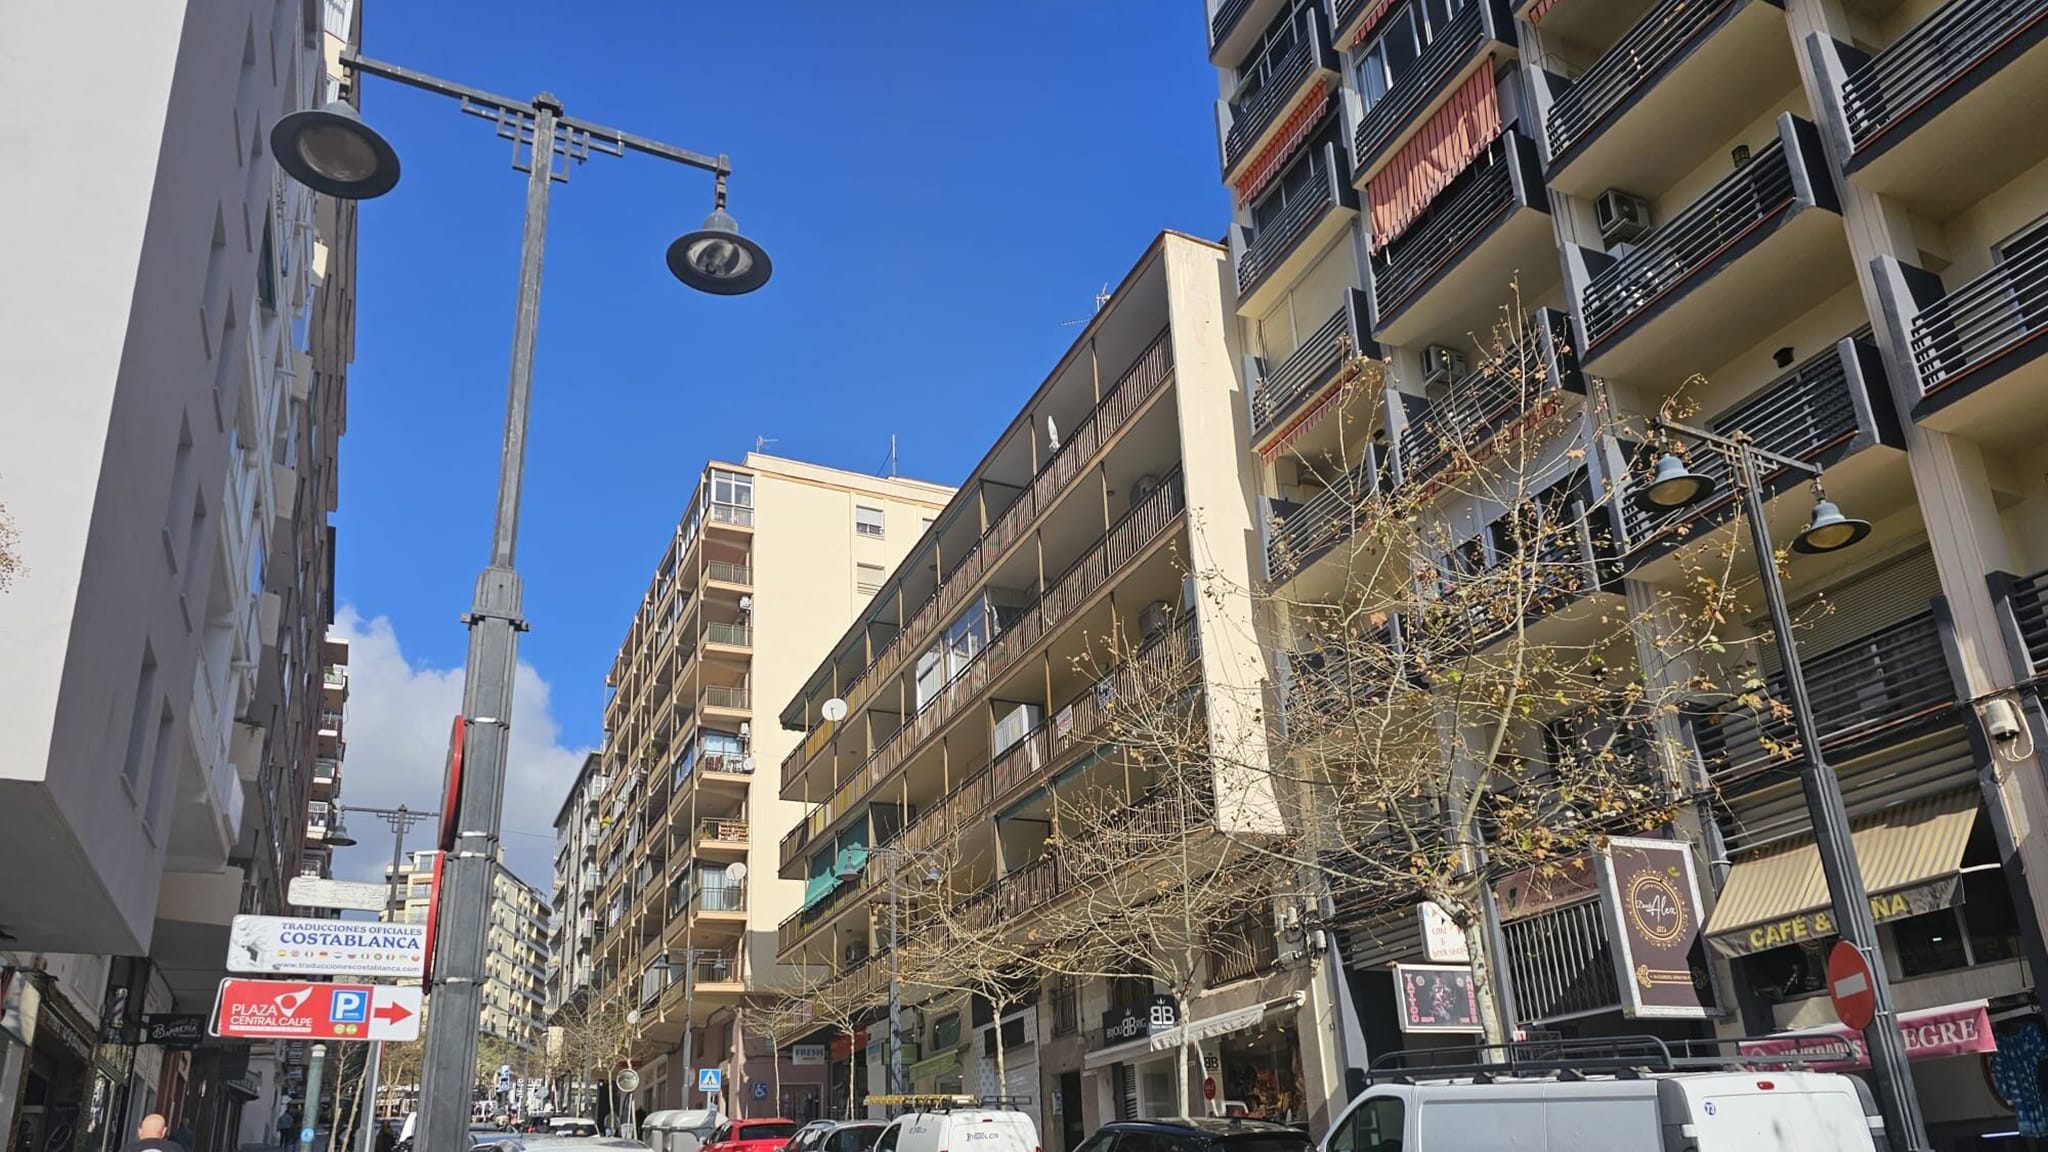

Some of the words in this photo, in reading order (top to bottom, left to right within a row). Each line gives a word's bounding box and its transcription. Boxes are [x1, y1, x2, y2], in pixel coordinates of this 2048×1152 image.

[1646, 895, 1677, 924] Alex
[279, 931, 420, 950] COSTABLANCA
[281, 922, 367, 934] TRADUCCIONES
[368, 926, 423, 936] OFICIALES
[1750, 914, 1807, 948] CAFÉ
[1814, 912, 1832, 932] &
[231, 1002, 278, 1017] PLAZA
[335, 992, 360, 1020] P
[230, 1015, 278, 1027] CENTRAL
[278, 1016, 313, 1027] CALPE
[1901, 1018, 1979, 1051] EGRE
